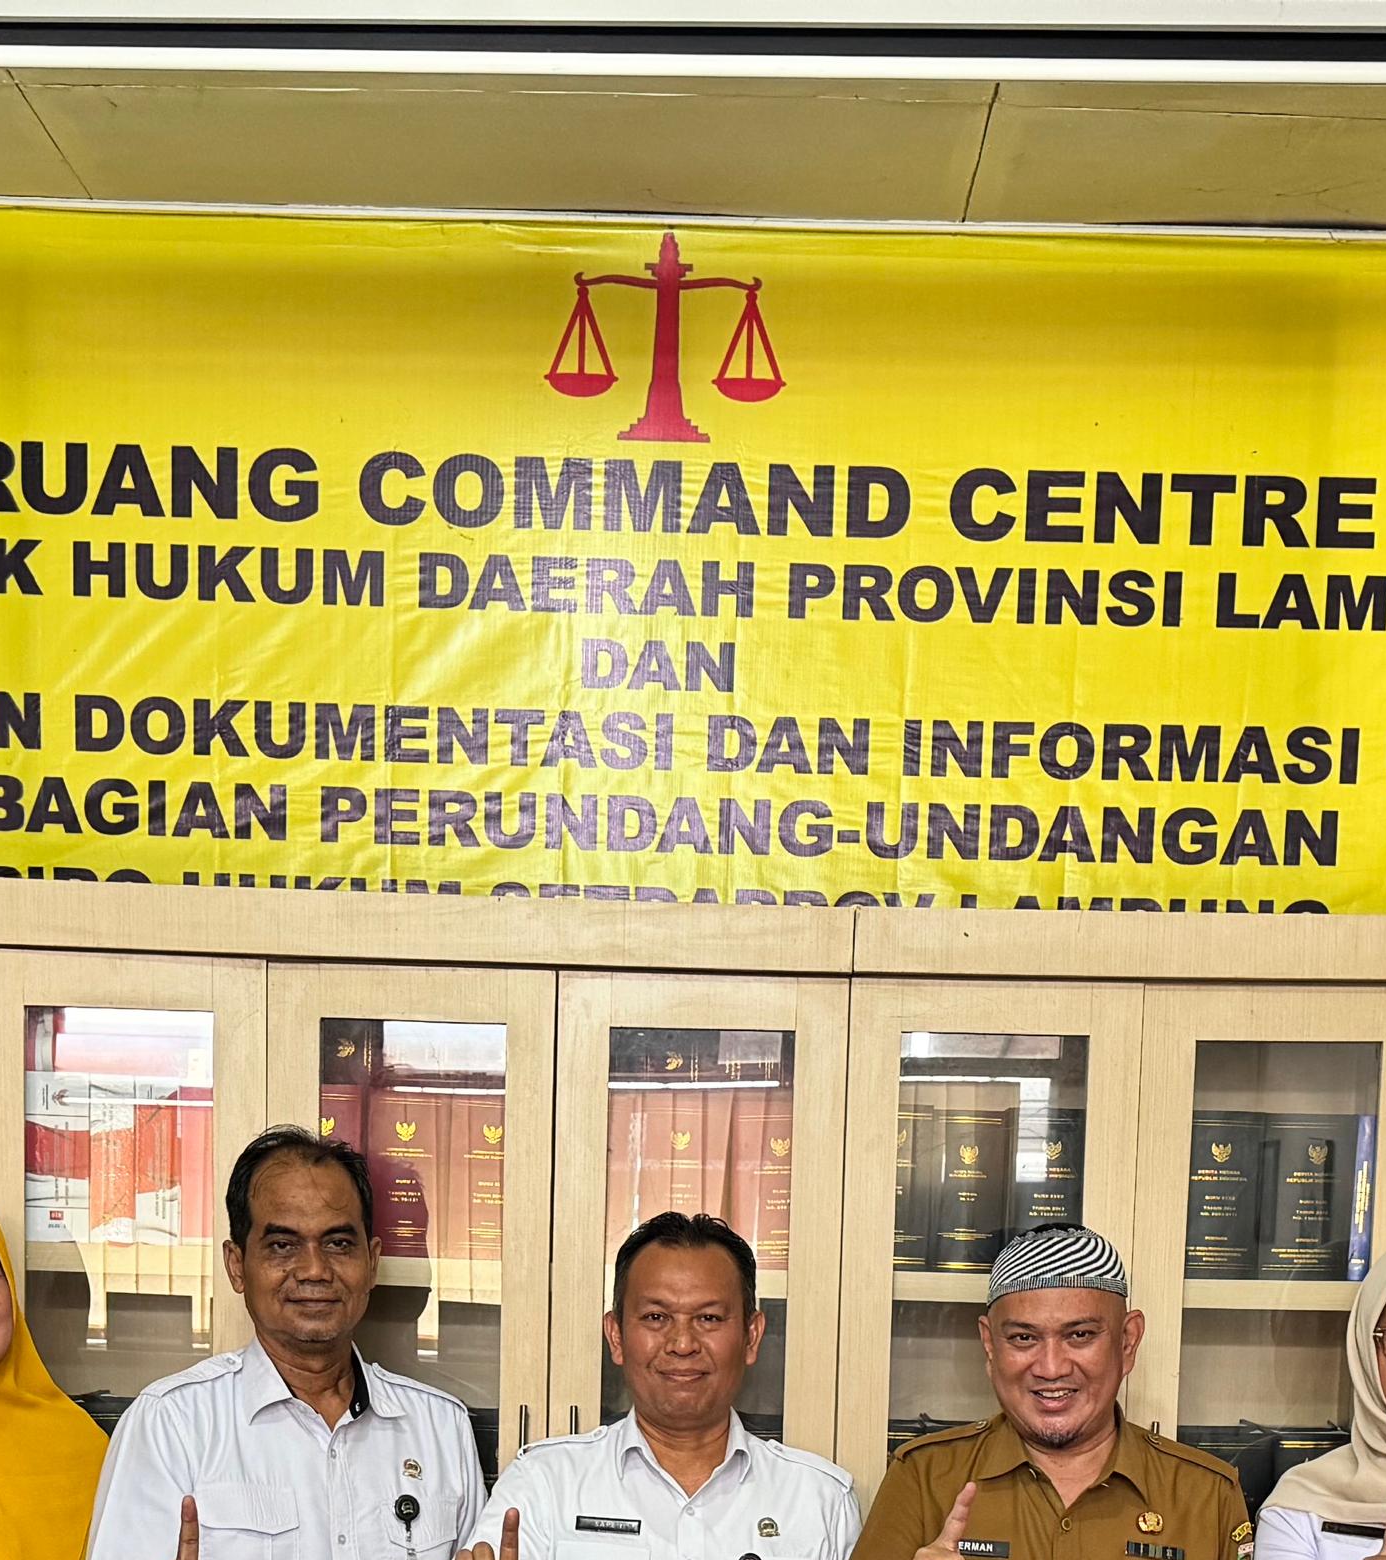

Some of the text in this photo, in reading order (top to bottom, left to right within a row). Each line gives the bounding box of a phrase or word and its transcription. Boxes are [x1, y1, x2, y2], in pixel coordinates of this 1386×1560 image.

[359, 450, 910, 538] COMMAND
[949, 466, 1377, 550] CENTRE
[73, 545, 385, 608] HUKUM
[417, 552, 755, 621] DAERAH
[786, 563, 1184, 629] PROVINSI
[580, 637, 737, 694] DAN
[75, 694, 673, 772] DOKUMENTASI
[707, 715, 871, 777] DAN
[903, 718, 1360, 787] INFORMASI
[319, 786, 1342, 868] PERUNDANG-UNDANGAN
[958, 1541, 993, 1552] ERMAN
